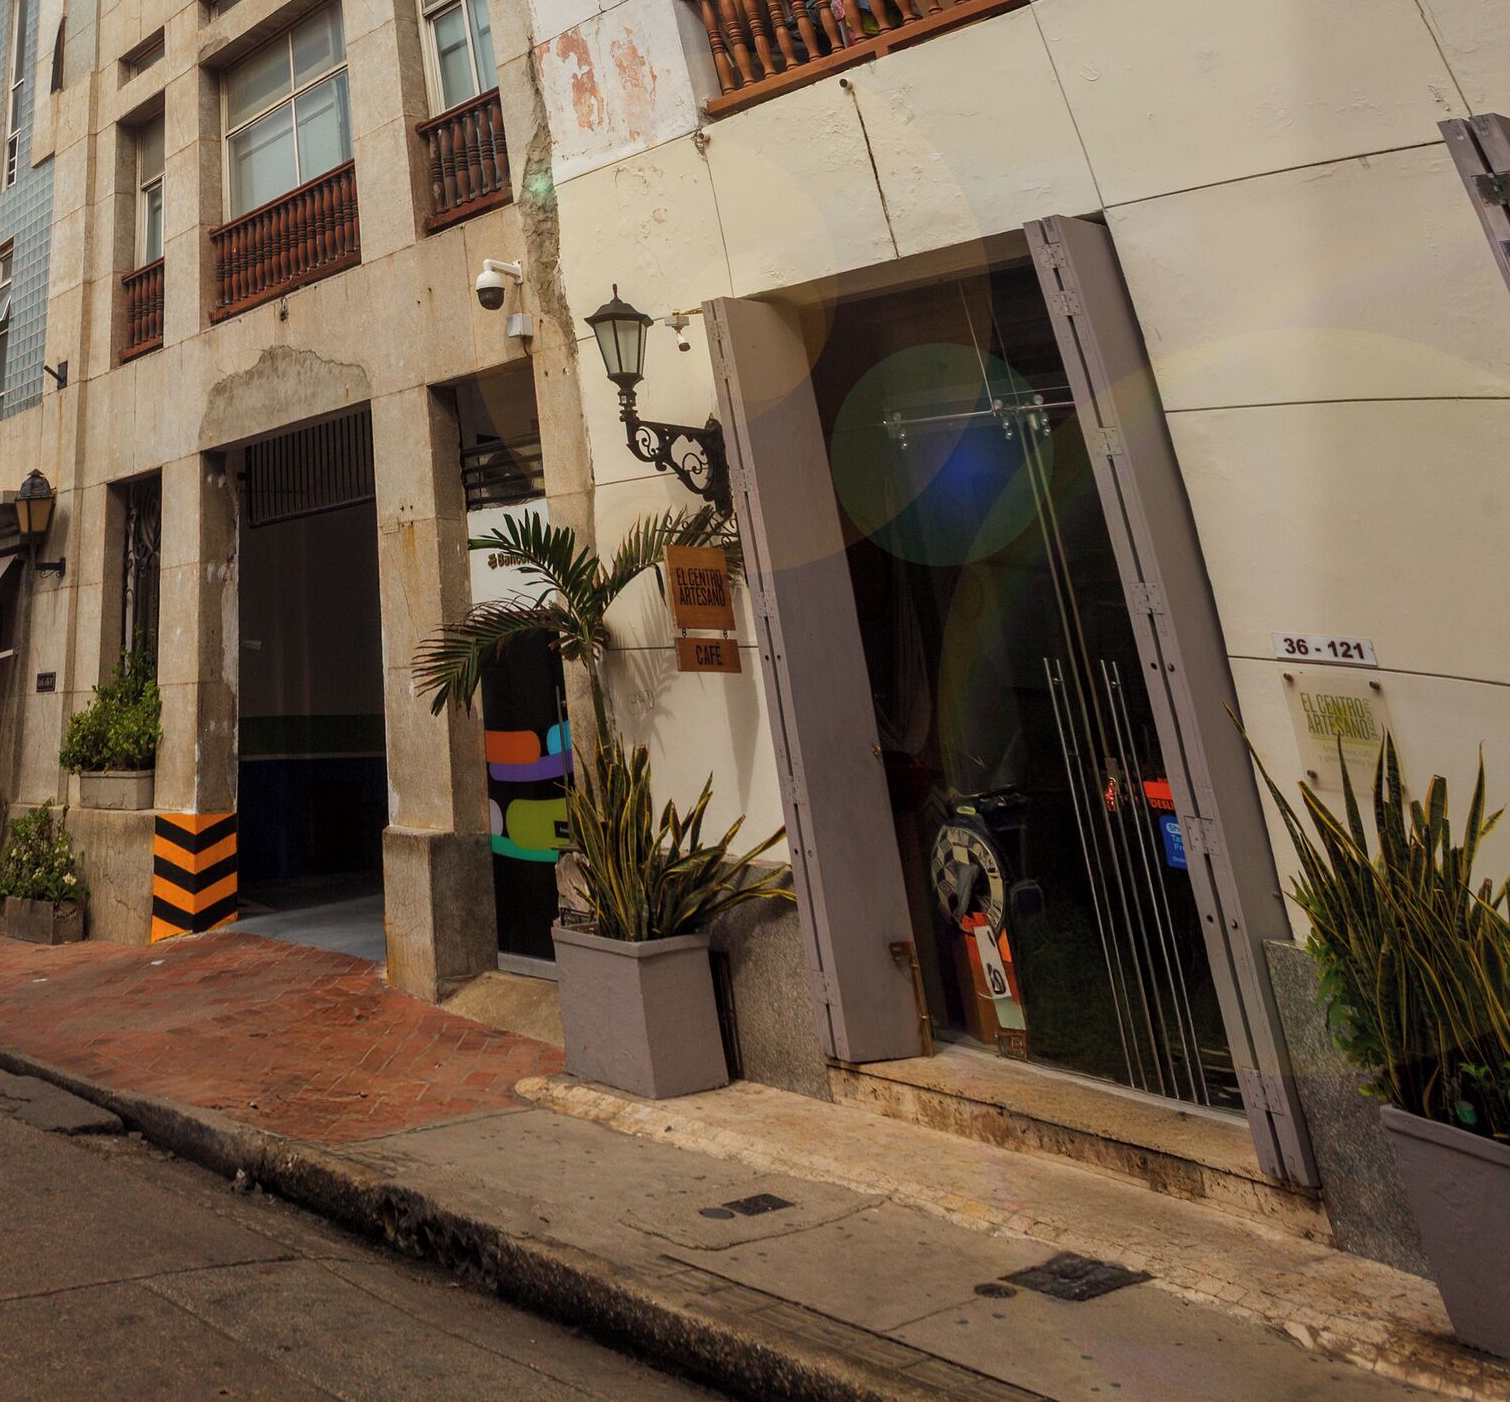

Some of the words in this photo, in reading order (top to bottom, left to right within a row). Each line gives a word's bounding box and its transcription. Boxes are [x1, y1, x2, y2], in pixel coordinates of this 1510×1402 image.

[676, 567, 688, 586] EL
[688, 568, 723, 587] CENTRO
[680, 586, 727, 607] ARTESANO
[696, 642, 723, 666] CAFÉ
[1283, 637, 1309, 656] 36
[1327, 639, 1365, 660] 121
[1299, 692, 1316, 713] EL
[1316, 694, 1365, 719] CENTRO
[1306, 714, 1371, 741] ARTESANO
